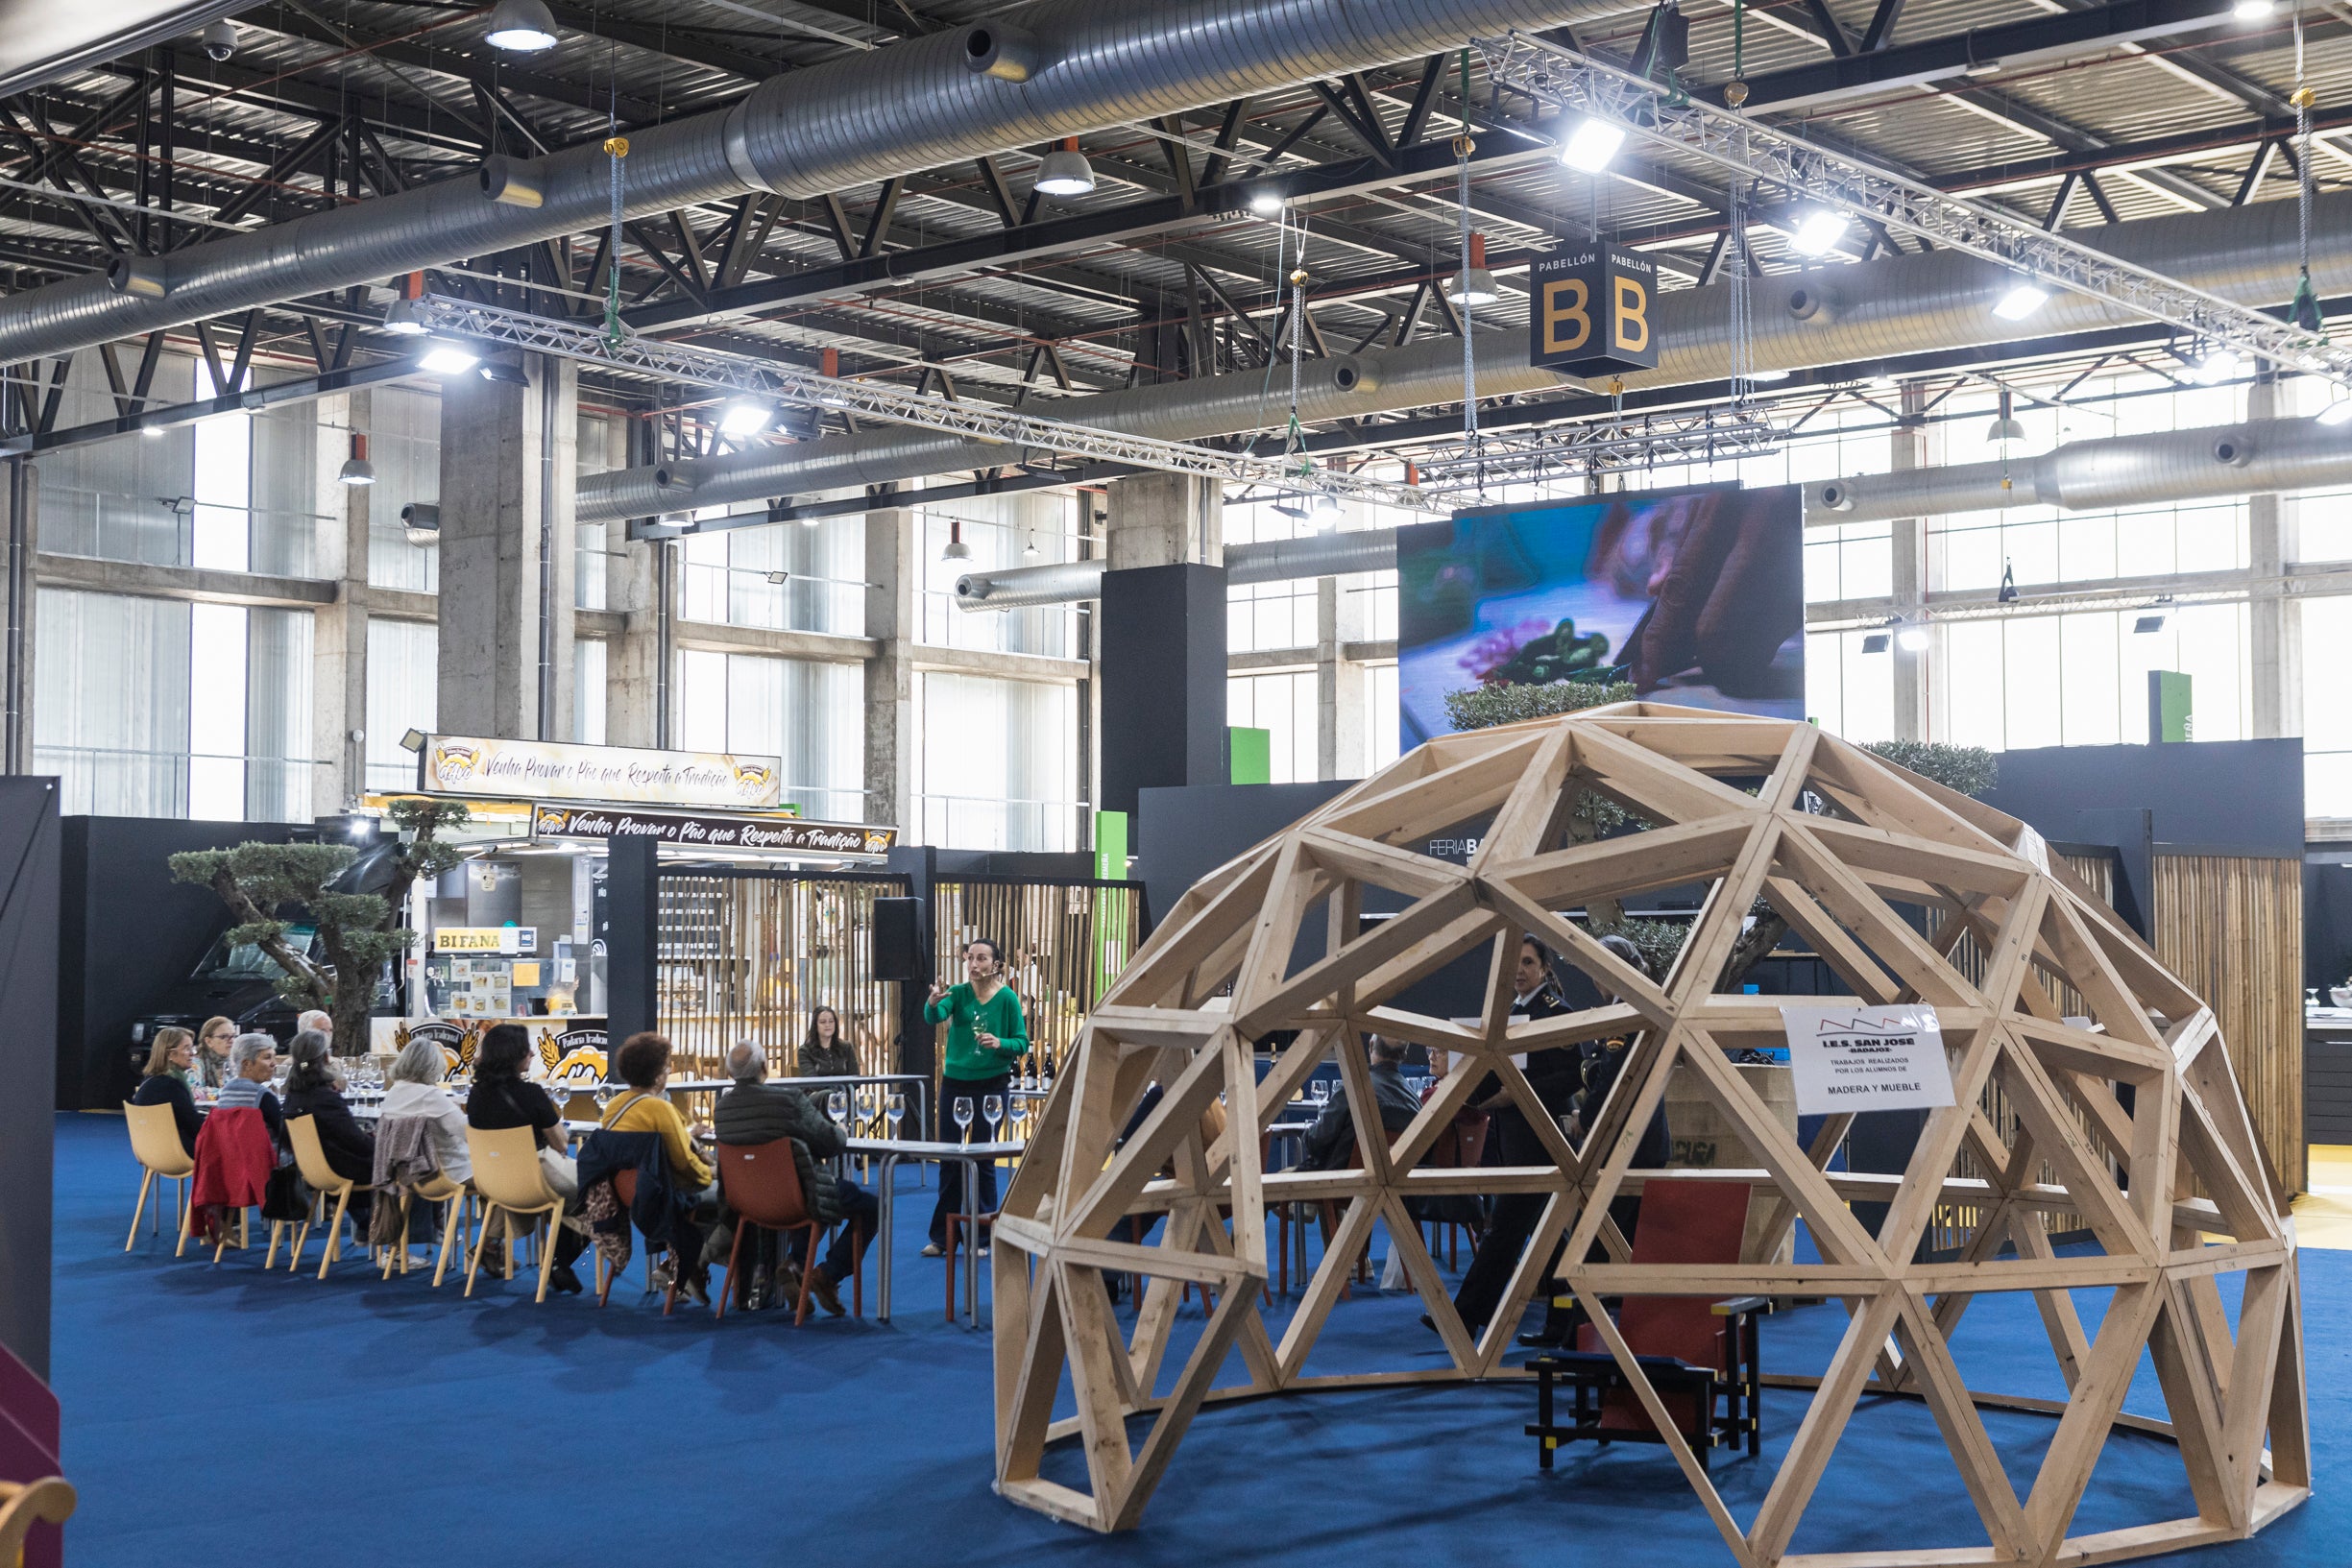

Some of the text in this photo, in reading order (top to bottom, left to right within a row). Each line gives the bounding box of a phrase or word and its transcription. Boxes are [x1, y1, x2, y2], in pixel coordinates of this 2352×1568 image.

[1539, 253, 1595, 273] PABELLÓN
[1612, 253, 1652, 273] PABELLÓN
[1543, 278, 1590, 354] B
[1614, 275, 1649, 352] B
[486, 751, 728, 791] Venha Provar o Pão que Respeita a Tradição
[569, 810, 861, 852] Venha Provar o Pão que Respeita a Tradição
[439, 935, 500, 948] BIFANA
[1855, 1039, 1881, 1048] SAN
[1828, 1081, 1922, 1095] MADERA Y MUEBLE
